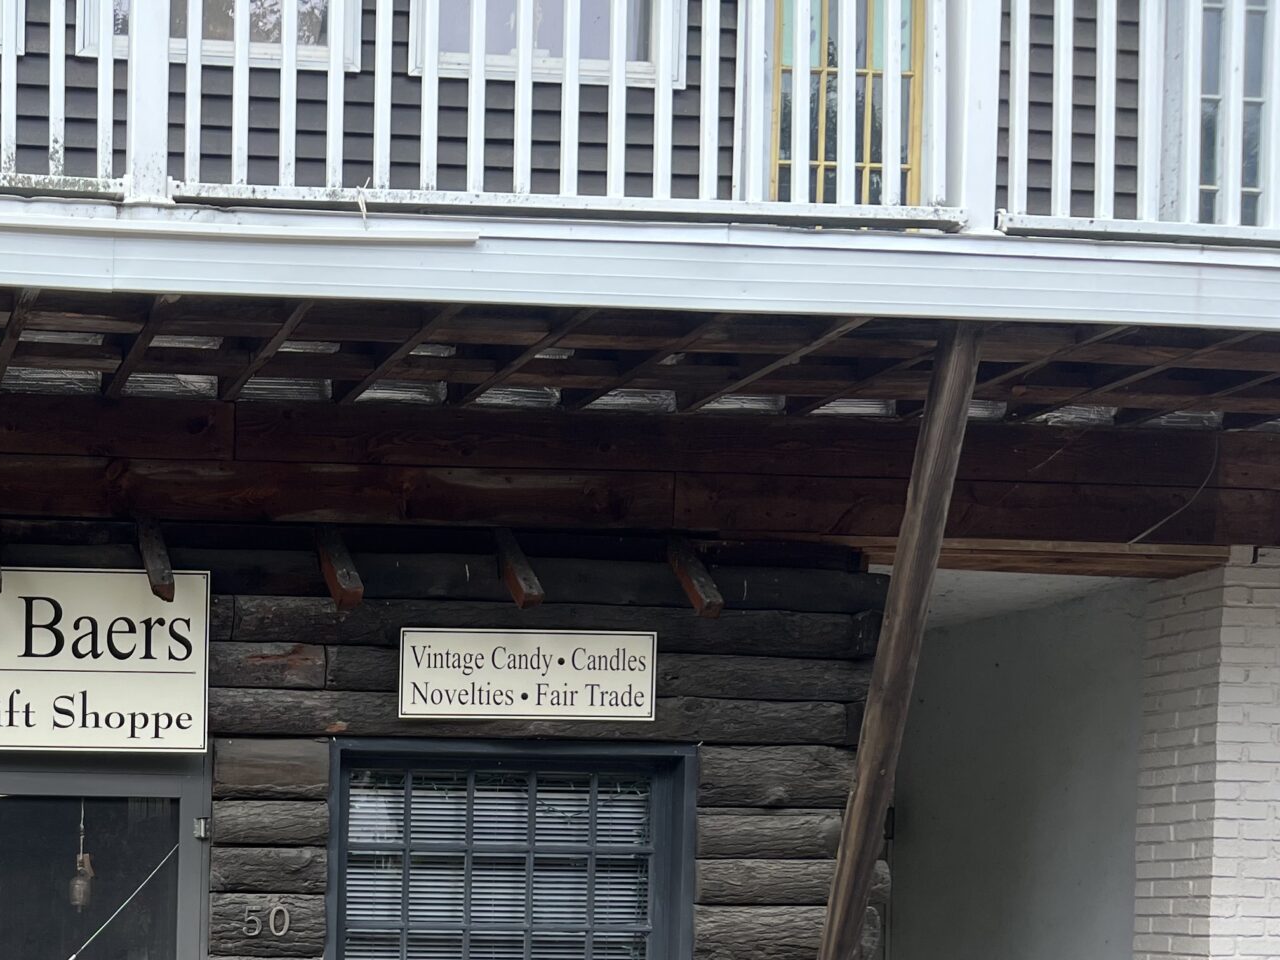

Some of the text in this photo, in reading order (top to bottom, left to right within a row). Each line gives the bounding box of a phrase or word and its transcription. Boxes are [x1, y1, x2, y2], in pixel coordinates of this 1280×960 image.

[17, 595, 193, 661] Baers
[410, 645, 647, 678] Vintage Candy Candles
[410, 681, 645, 708] Novelties Fair Trade
[52, 690, 193, 739] Shoppe
[242, 905, 290, 936] 50
